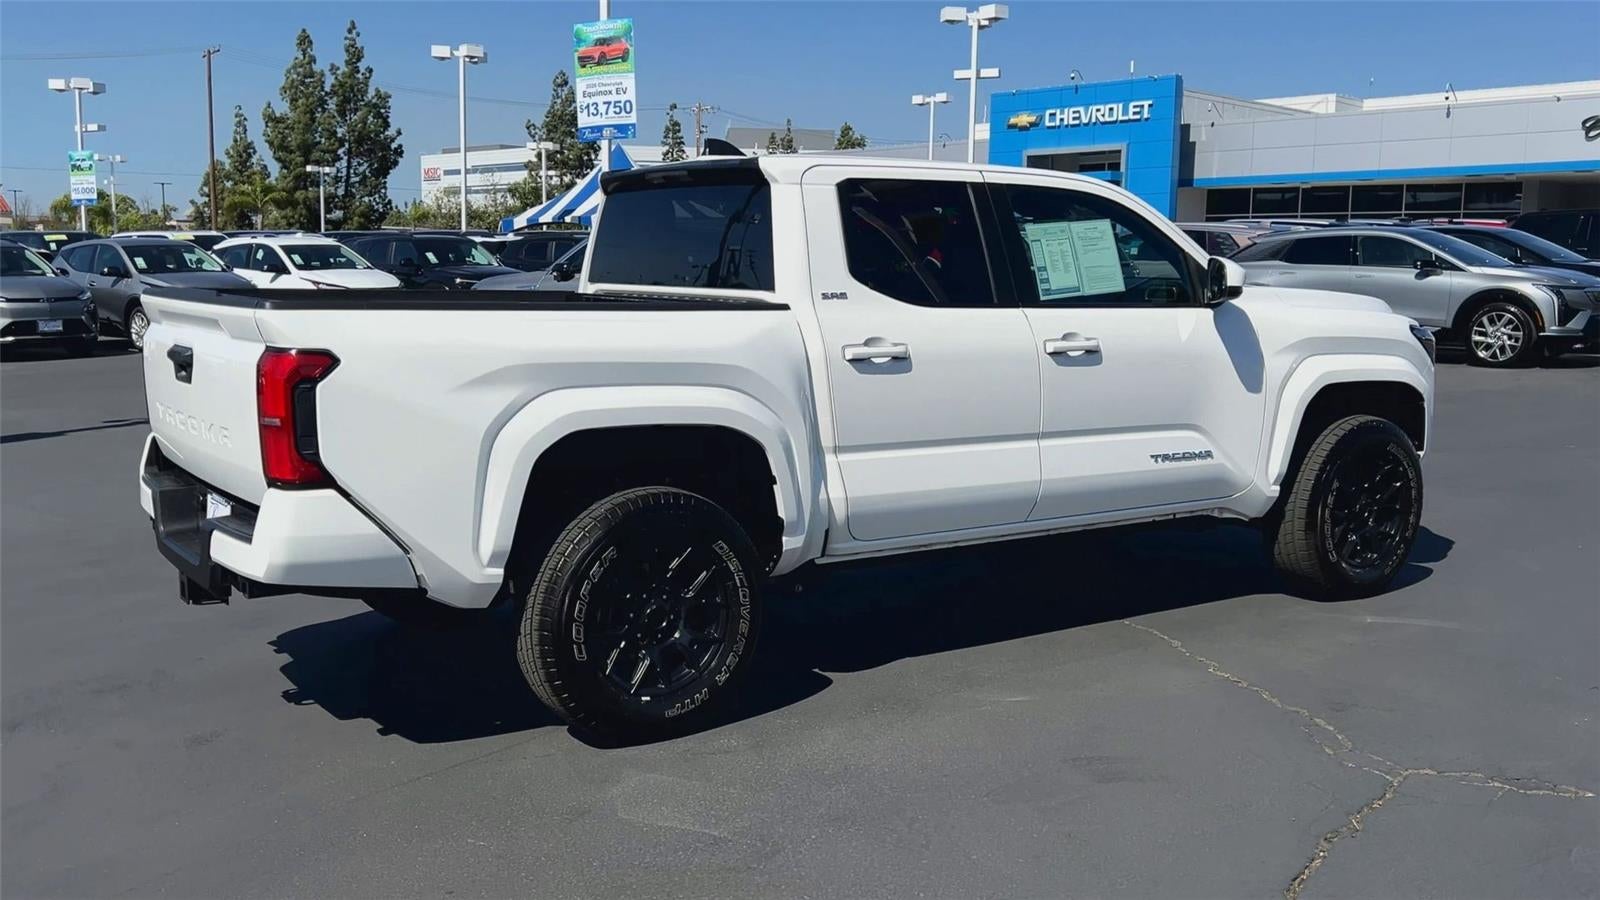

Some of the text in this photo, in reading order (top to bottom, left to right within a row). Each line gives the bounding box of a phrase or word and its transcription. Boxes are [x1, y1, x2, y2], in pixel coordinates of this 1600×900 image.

[582, 87, 628, 99] Equinox EV
[579, 99, 633, 119] $13,750
[1045, 100, 1153, 128] CHEVROLET
[156, 401, 233, 448] TACOMA
[1150, 450, 1214, 464] TACOMA
[572, 546, 617, 662] COOPER
[713, 540, 751, 686] DISCOVERER
